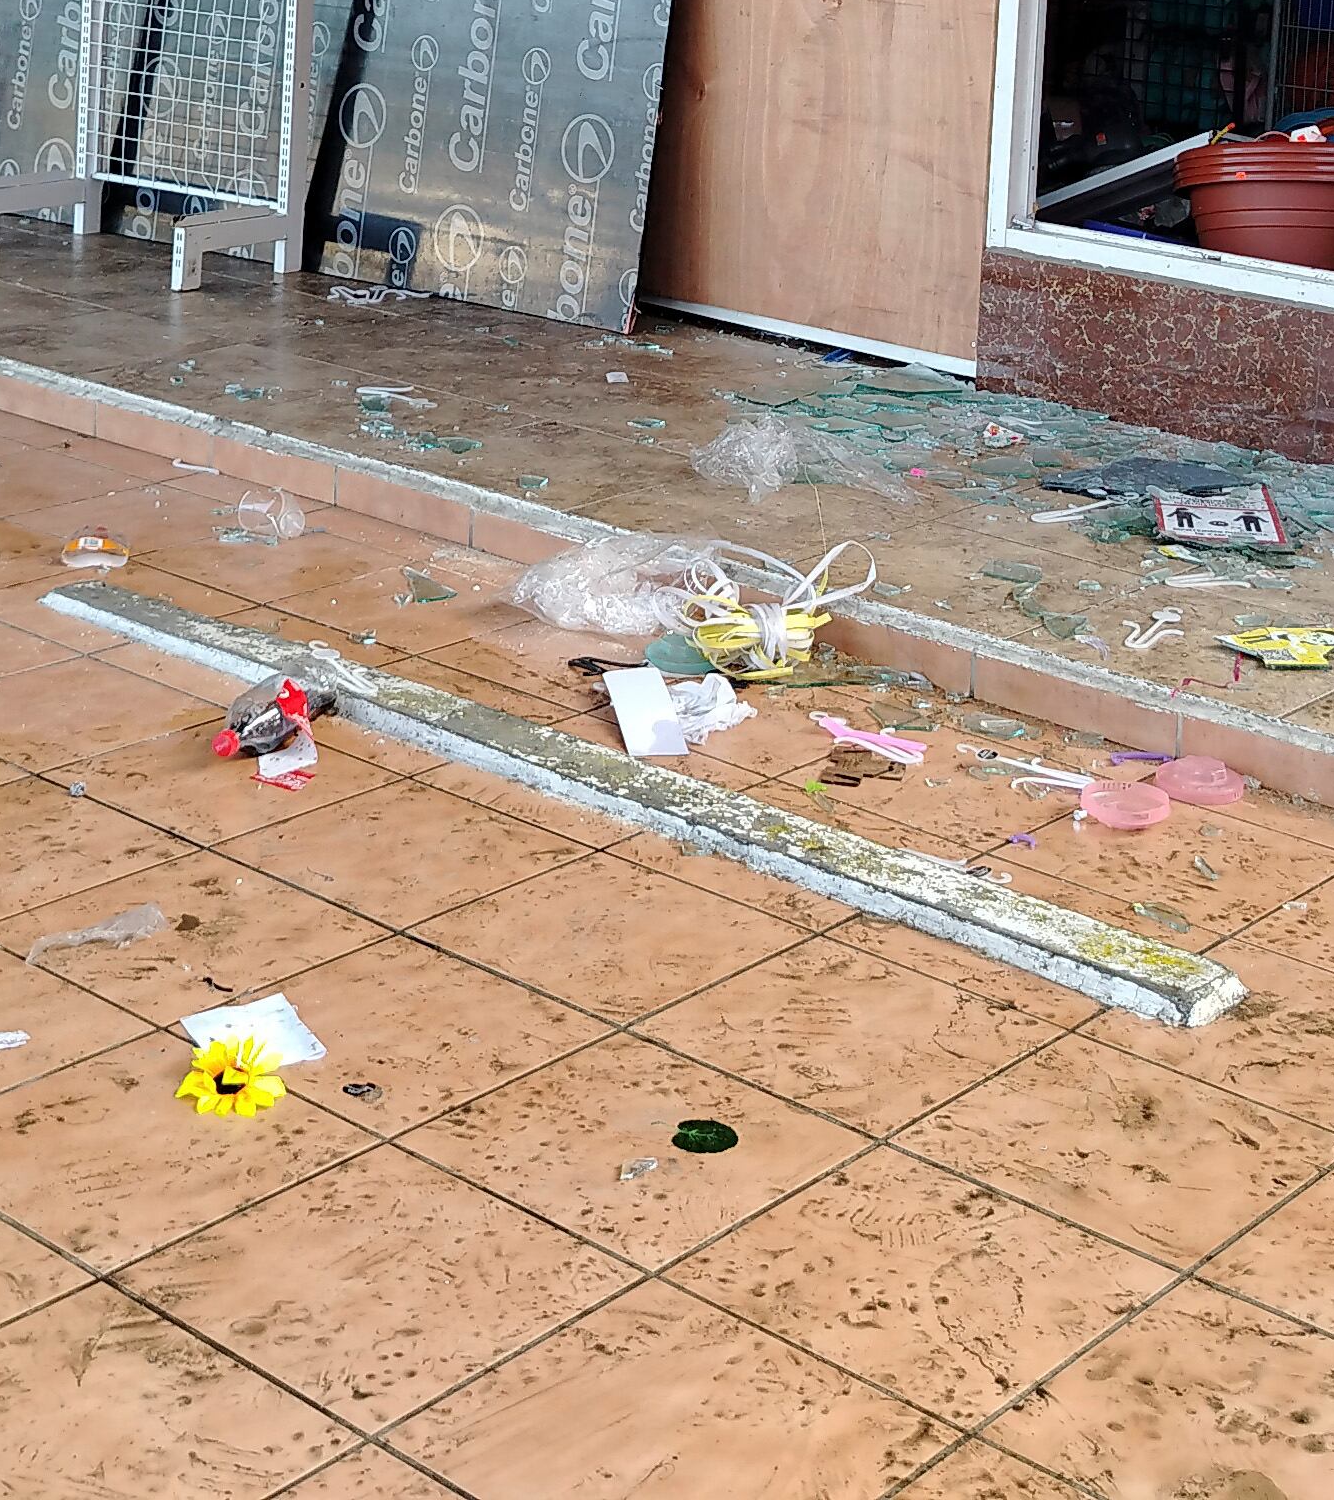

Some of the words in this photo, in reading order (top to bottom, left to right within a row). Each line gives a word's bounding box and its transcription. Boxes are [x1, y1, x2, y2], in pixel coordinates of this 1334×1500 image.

[7, 25, 32, 130] Carbone
[399, 76, 427, 195] Carbone
[509, 91, 539, 212] Carbone
[325, 158, 366, 279] bone
[547, 193, 592, 322] bone
